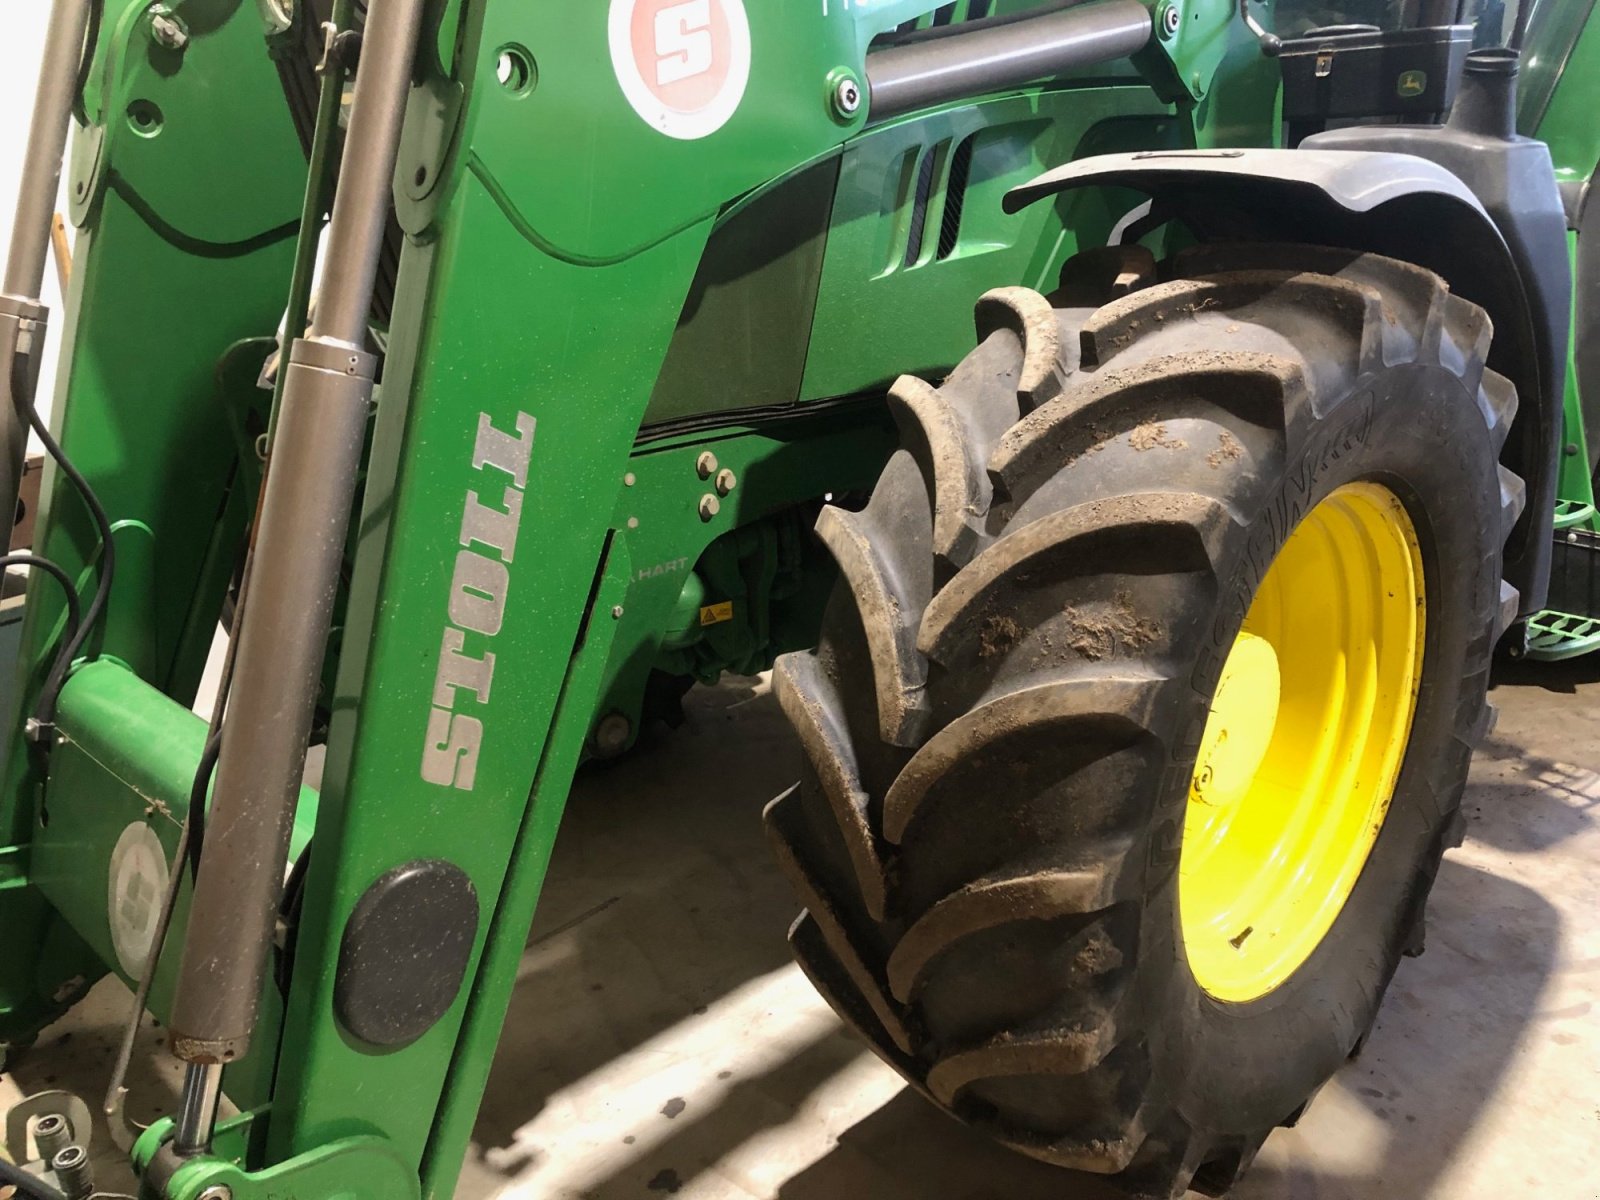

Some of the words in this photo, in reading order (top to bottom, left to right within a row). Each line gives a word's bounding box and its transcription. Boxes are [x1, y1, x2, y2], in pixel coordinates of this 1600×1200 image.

[654, 0, 712, 86] S
[421, 410, 537, 791] STOLL
[630, 556, 688, 583] HART
